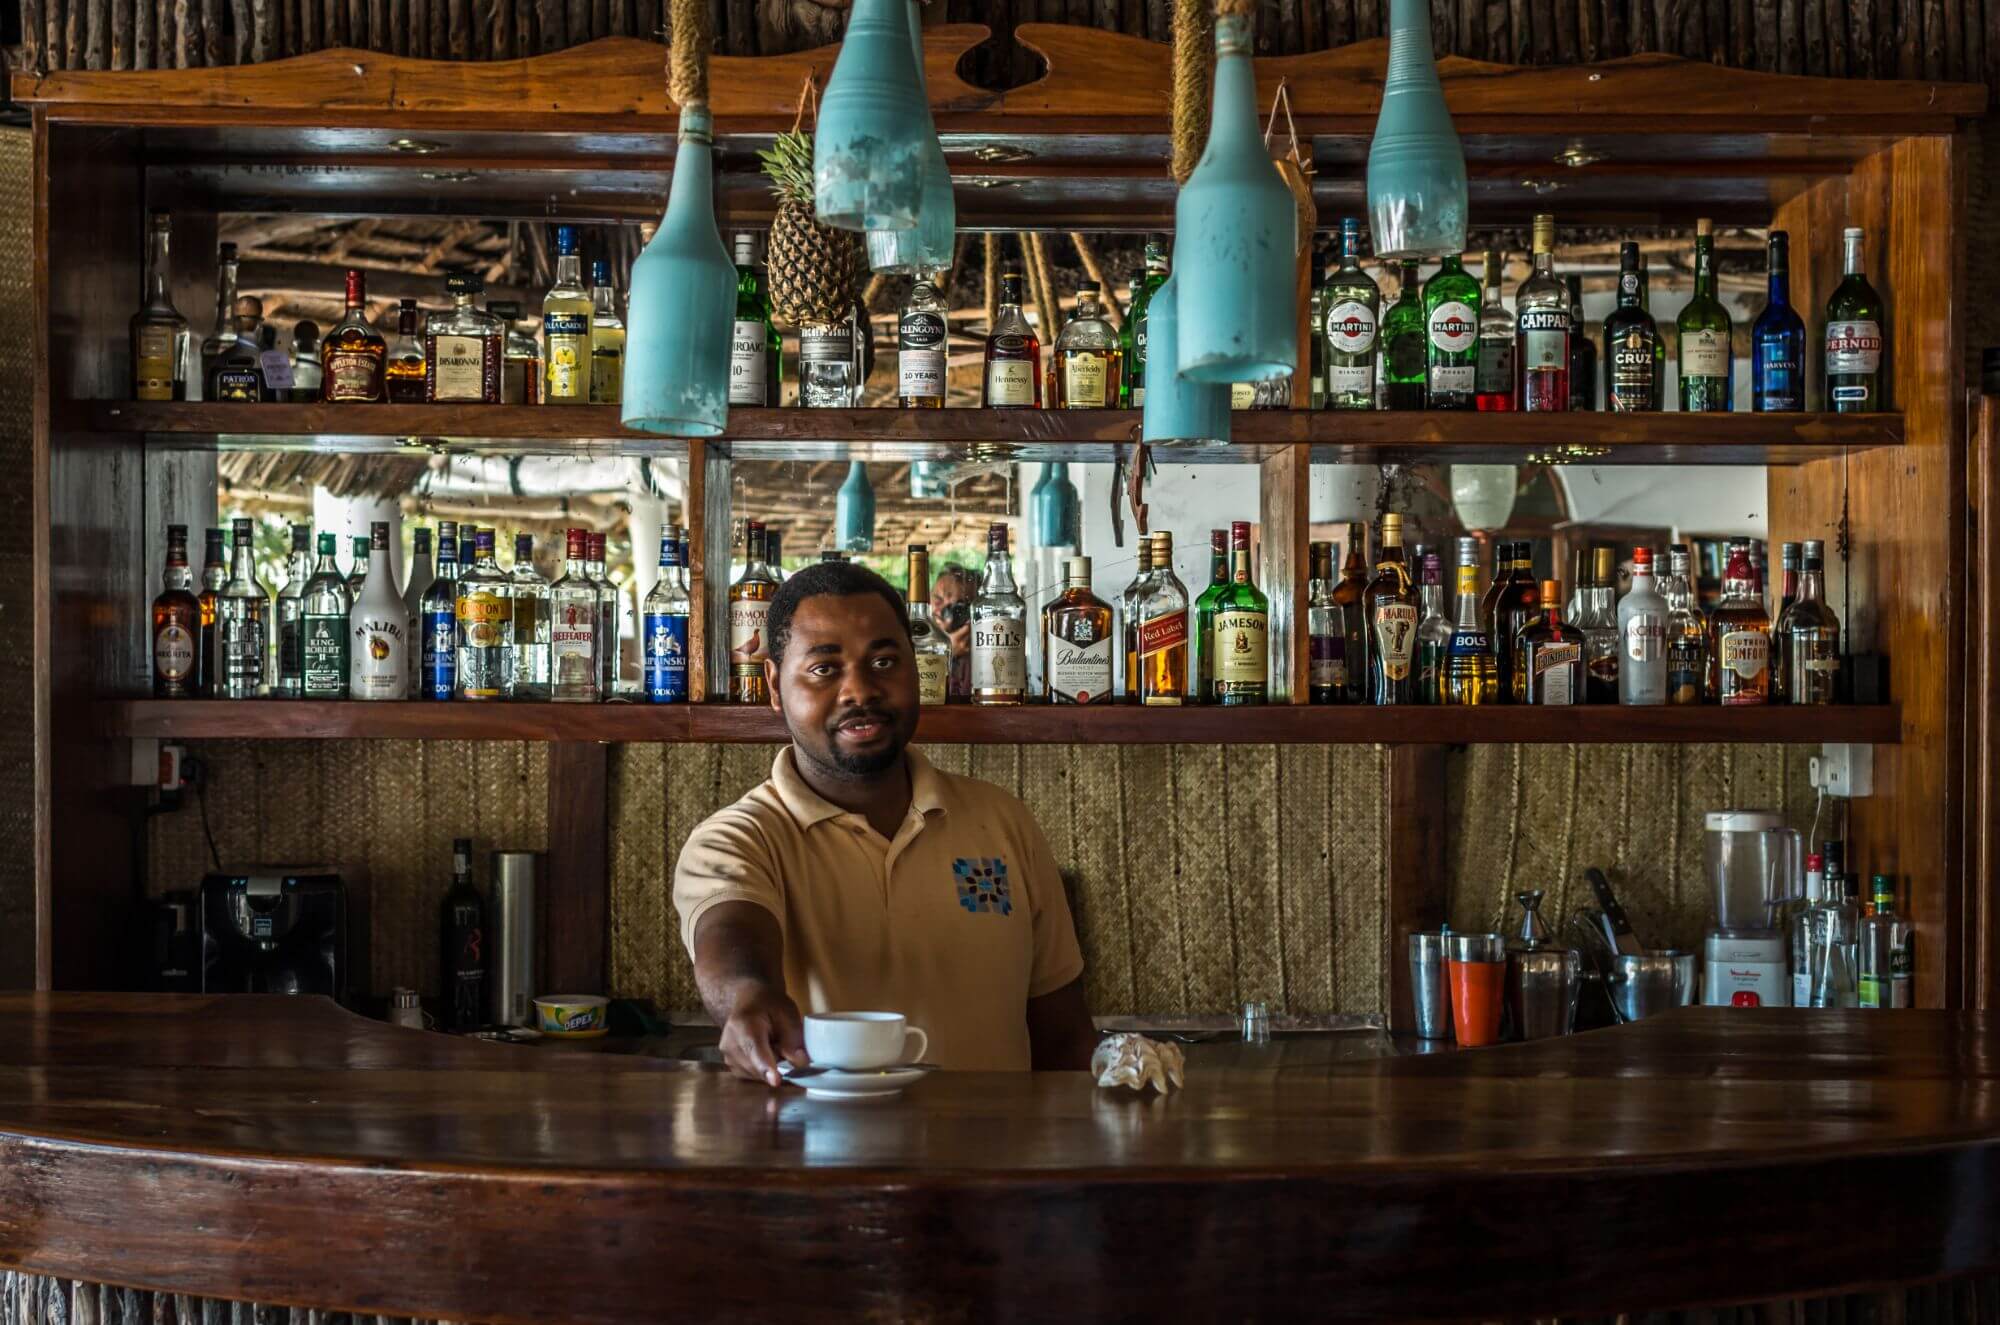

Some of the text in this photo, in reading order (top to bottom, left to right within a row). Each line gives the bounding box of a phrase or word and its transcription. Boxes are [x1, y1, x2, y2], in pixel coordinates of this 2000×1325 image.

[1521, 314, 1569, 329] CAMPAR
[1332, 323, 1372, 331] MARTINI
[1434, 323, 1474, 331] MARTINI
[1825, 339, 1879, 350] PERNOD
[439, 357, 480, 366] DISARONNO
[1615, 353, 1652, 364] CRUZ
[904, 371, 938, 380] 10 YEARS
[995, 375, 1028, 385] Hennessy
[735, 610, 769, 619] FAMOU
[735, 619, 769, 627] GROUS
[1218, 617, 1265, 632] JAMESON
[355, 621, 402, 641] MALIBU
[1144, 628, 1161, 642] Red
[1161, 620, 1184, 636] Label
[552, 632, 592, 643] BEEFEATER
[976, 631, 1021, 647] BELL'S
[1456, 636, 1488, 646] BOLS
